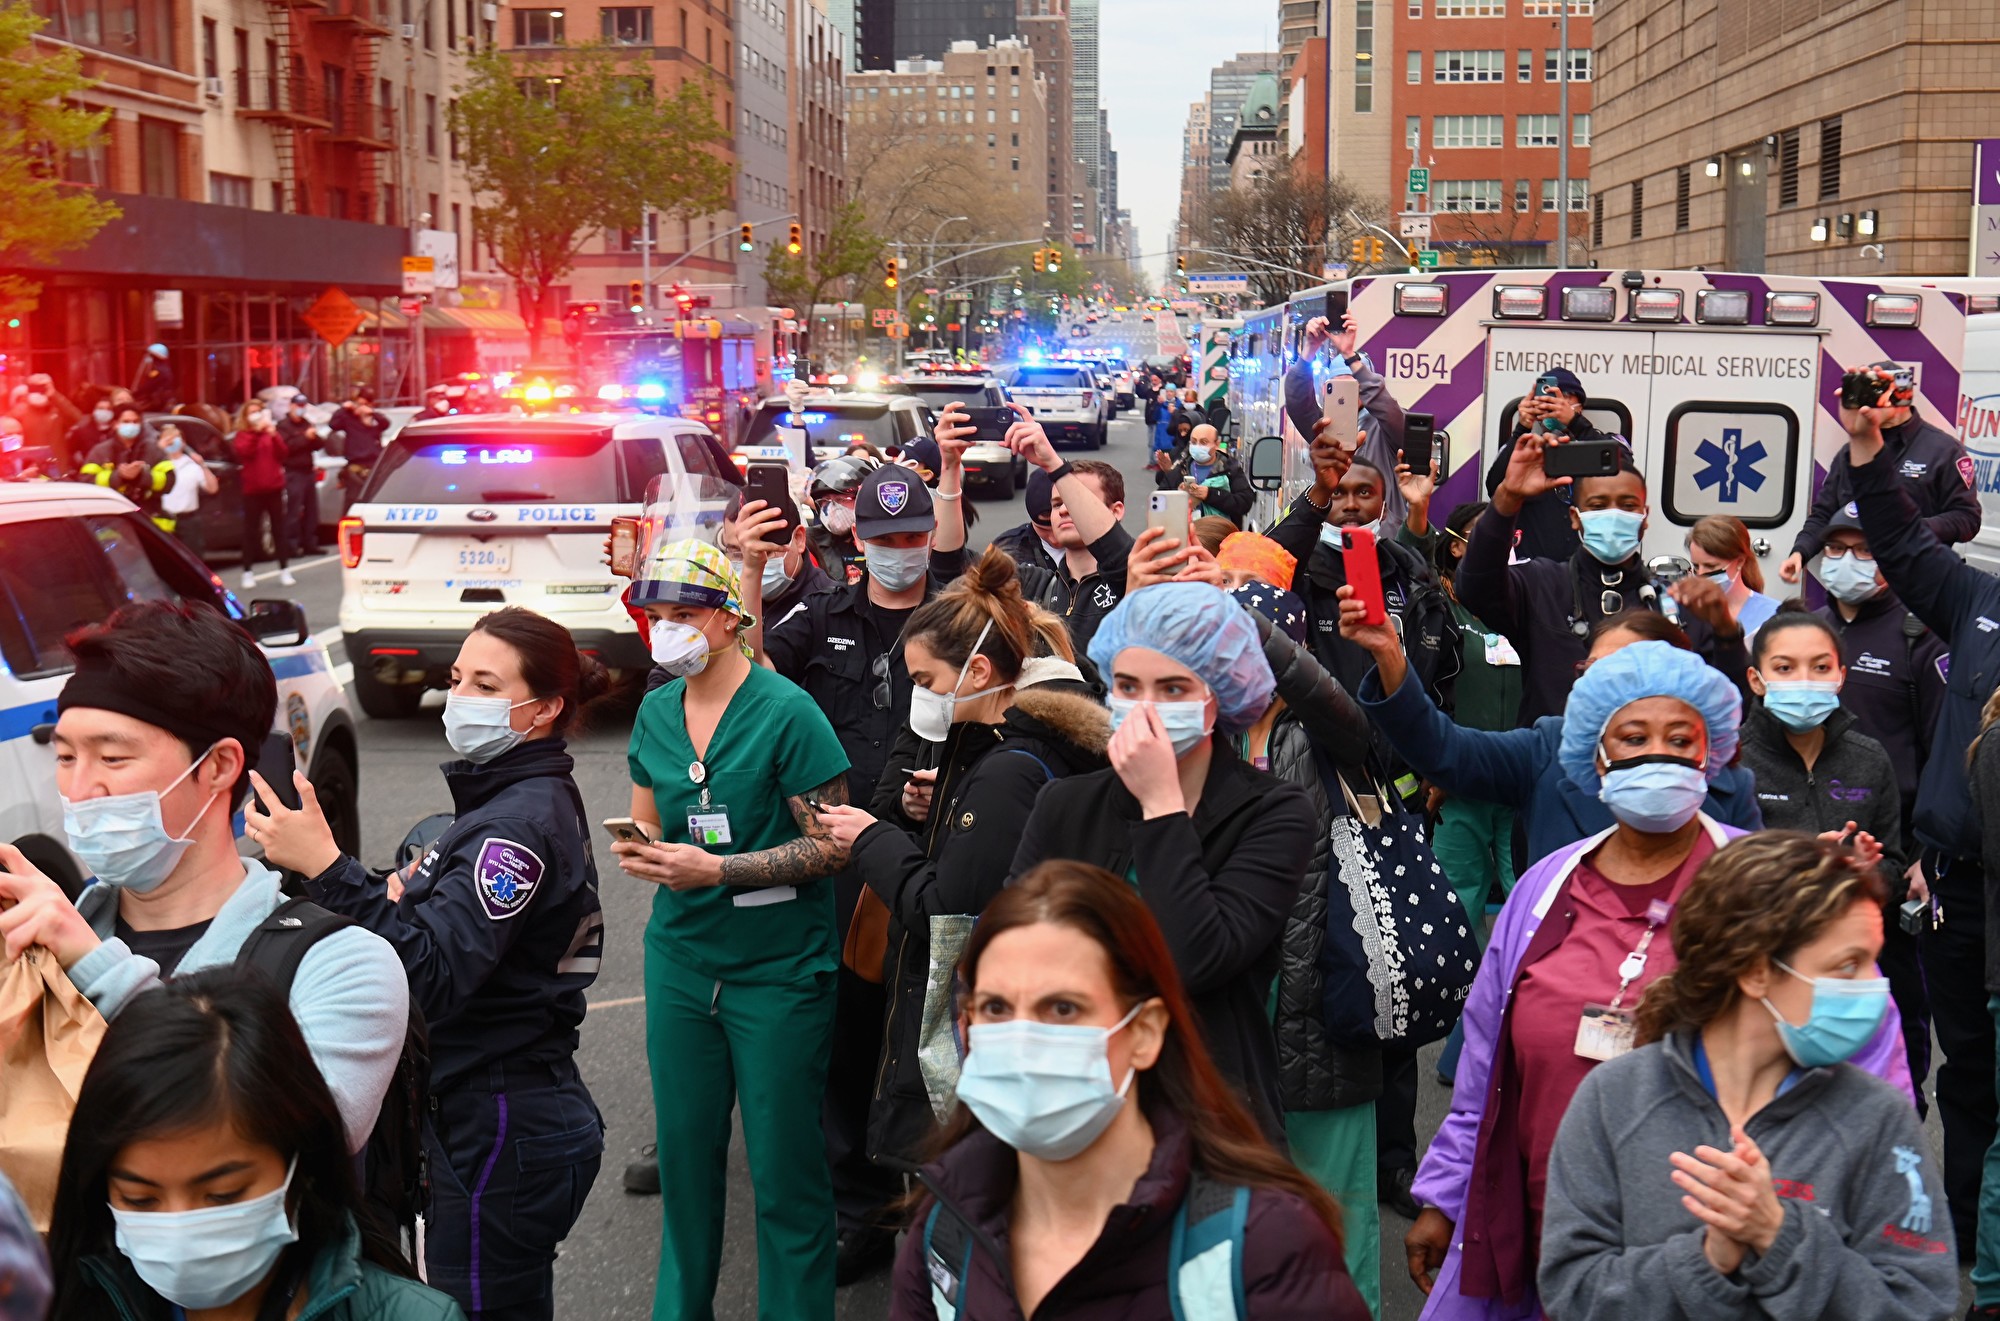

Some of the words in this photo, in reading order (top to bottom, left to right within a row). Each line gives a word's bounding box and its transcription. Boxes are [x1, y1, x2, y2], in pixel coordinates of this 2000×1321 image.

[1389, 353, 1448, 379] 1954
[1494, 351, 1614, 374] EMERGENCY
[1622, 354, 1708, 376] MEDICAL
[1716, 356, 1812, 379] SERVICES
[480, 449, 532, 464] LAW
[385, 508, 438, 521] NYPD
[518, 508, 597, 522] POLICE
[459, 551, 495, 565] 5320
